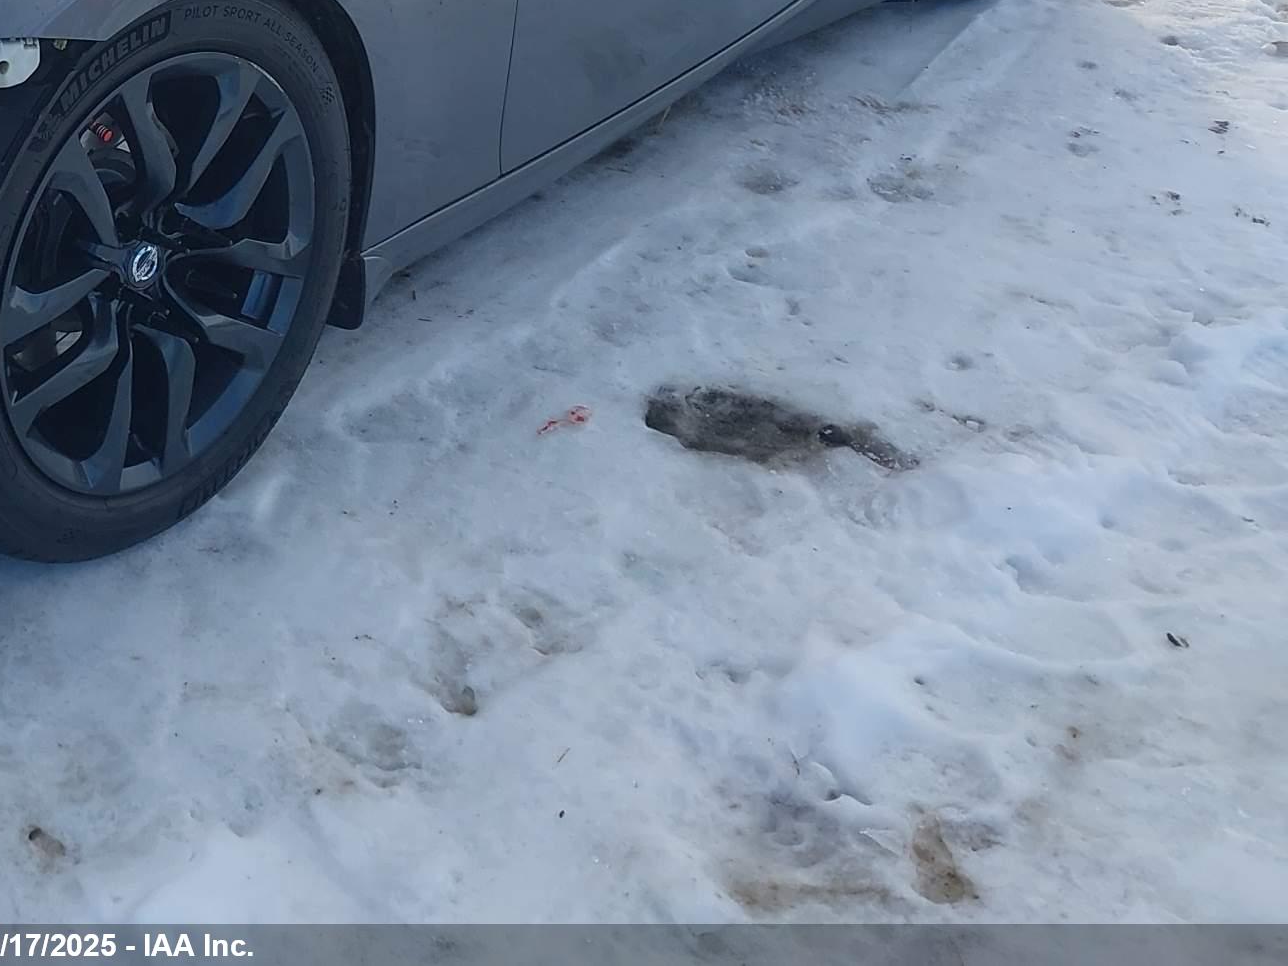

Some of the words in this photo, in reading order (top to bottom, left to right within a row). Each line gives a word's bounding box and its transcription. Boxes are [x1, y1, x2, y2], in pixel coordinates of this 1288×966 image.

[59, 17, 167, 113] MICHELIN
[184, 5, 218, 21] PILOT
[223, 5, 262, 24] SPORT
[263, 18, 282, 36] ALL
[283, 31, 320, 73] SEASON
